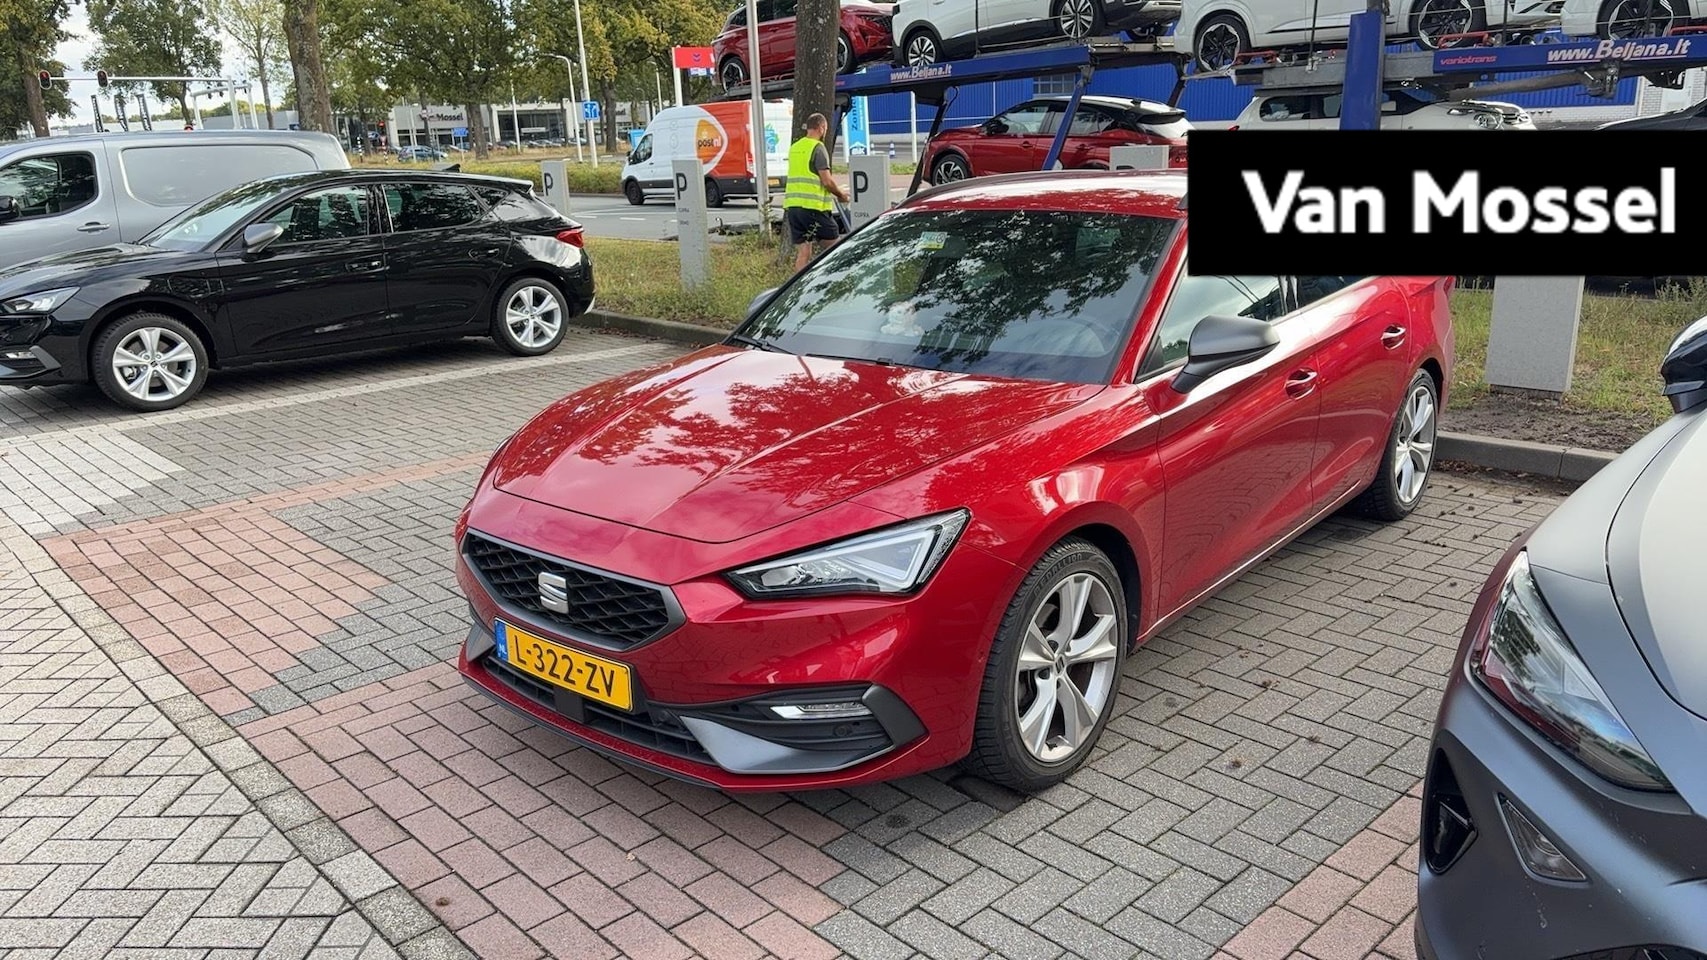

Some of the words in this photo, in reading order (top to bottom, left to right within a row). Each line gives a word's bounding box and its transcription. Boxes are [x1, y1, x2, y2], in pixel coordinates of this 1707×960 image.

[1440, 55, 1497, 65] variotrans
[1546, 38, 1692, 62] www.Beljana.lt
[890, 63, 953, 81] www.Beljana.lt
[544, 172, 554, 196] P
[676, 172, 687, 200] P
[853, 171, 868, 202] P
[514, 634, 615, 698] L-322-ZV
